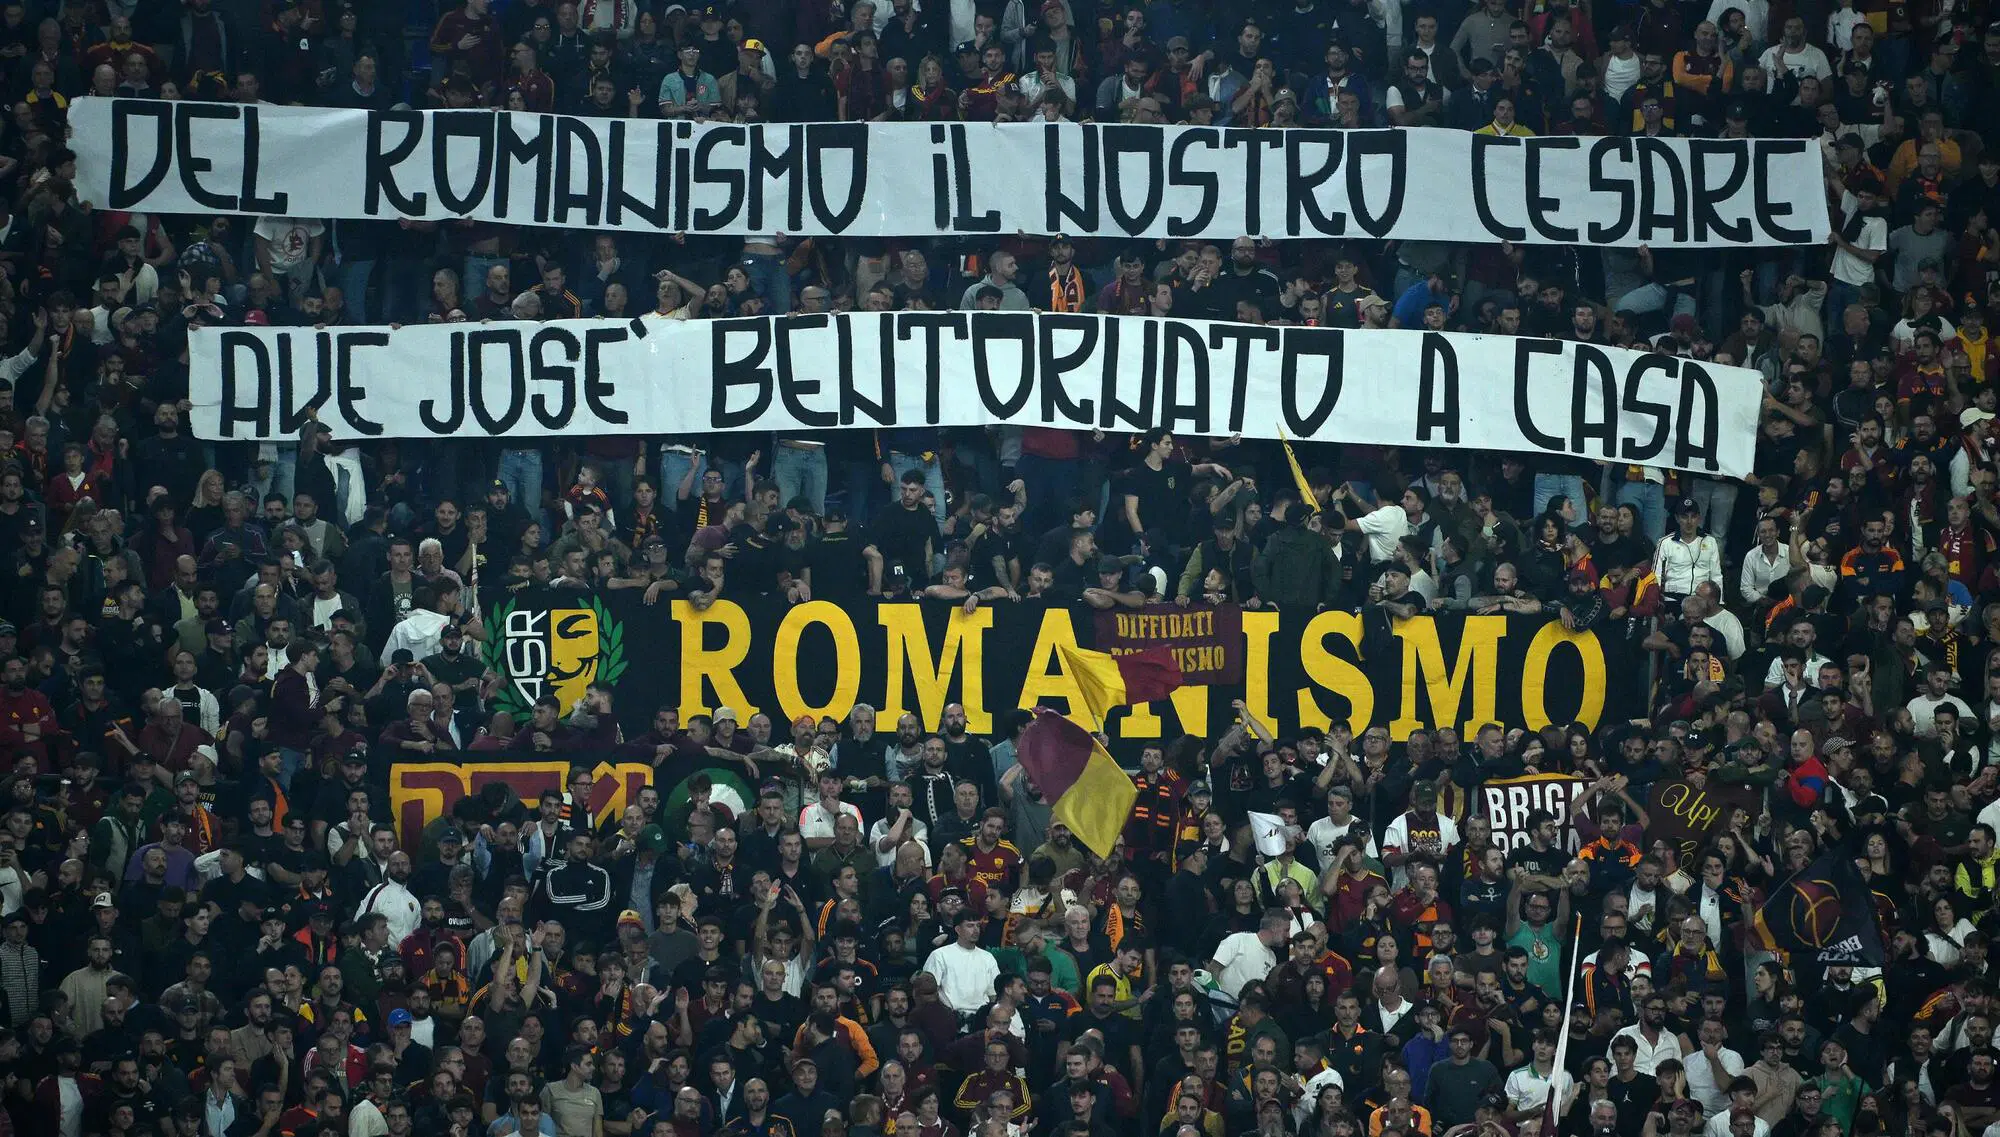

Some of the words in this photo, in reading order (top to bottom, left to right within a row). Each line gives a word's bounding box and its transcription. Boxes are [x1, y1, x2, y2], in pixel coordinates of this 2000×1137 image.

[108, 99, 288, 215] DEL
[1045, 123, 1406, 237] NOSTRO
[1471, 135, 1813, 243] CESARE
[220, 331, 390, 438] AVE
[711, 311, 1344, 438] BENTORNATO
[1416, 332, 1460, 443] A
[1514, 337, 1719, 471] CASA
[505, 610, 547, 707] ASR
[1115, 611, 1214, 639] DIFFIDATI
